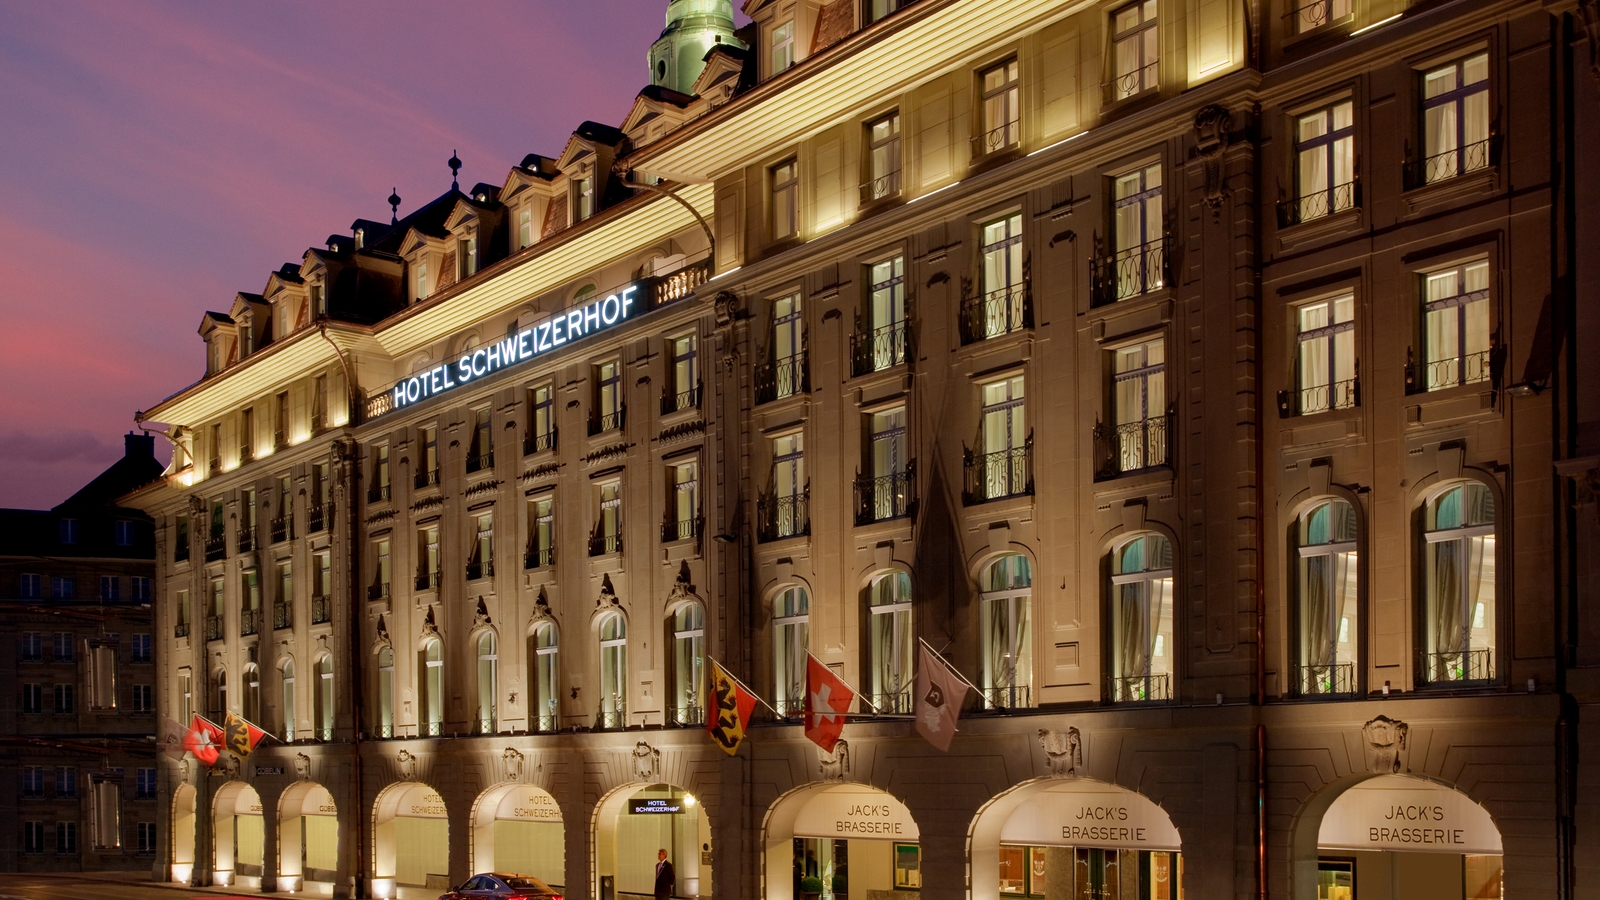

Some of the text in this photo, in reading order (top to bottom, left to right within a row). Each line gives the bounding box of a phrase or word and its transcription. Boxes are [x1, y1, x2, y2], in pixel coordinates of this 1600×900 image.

[394, 286, 638, 408] HOTEL SCHWEIZERHOF
[528, 795, 552, 804] HOTEL
[847, 805, 890, 816] JACK'S
[1075, 806, 1128, 820] JACK'S
[1384, 805, 1444, 821] JACK'S
[836, 821, 902, 834] BRASSERIE
[1062, 826, 1146, 841] BRASSERIE
[1369, 827, 1465, 844] BRASSERIE
